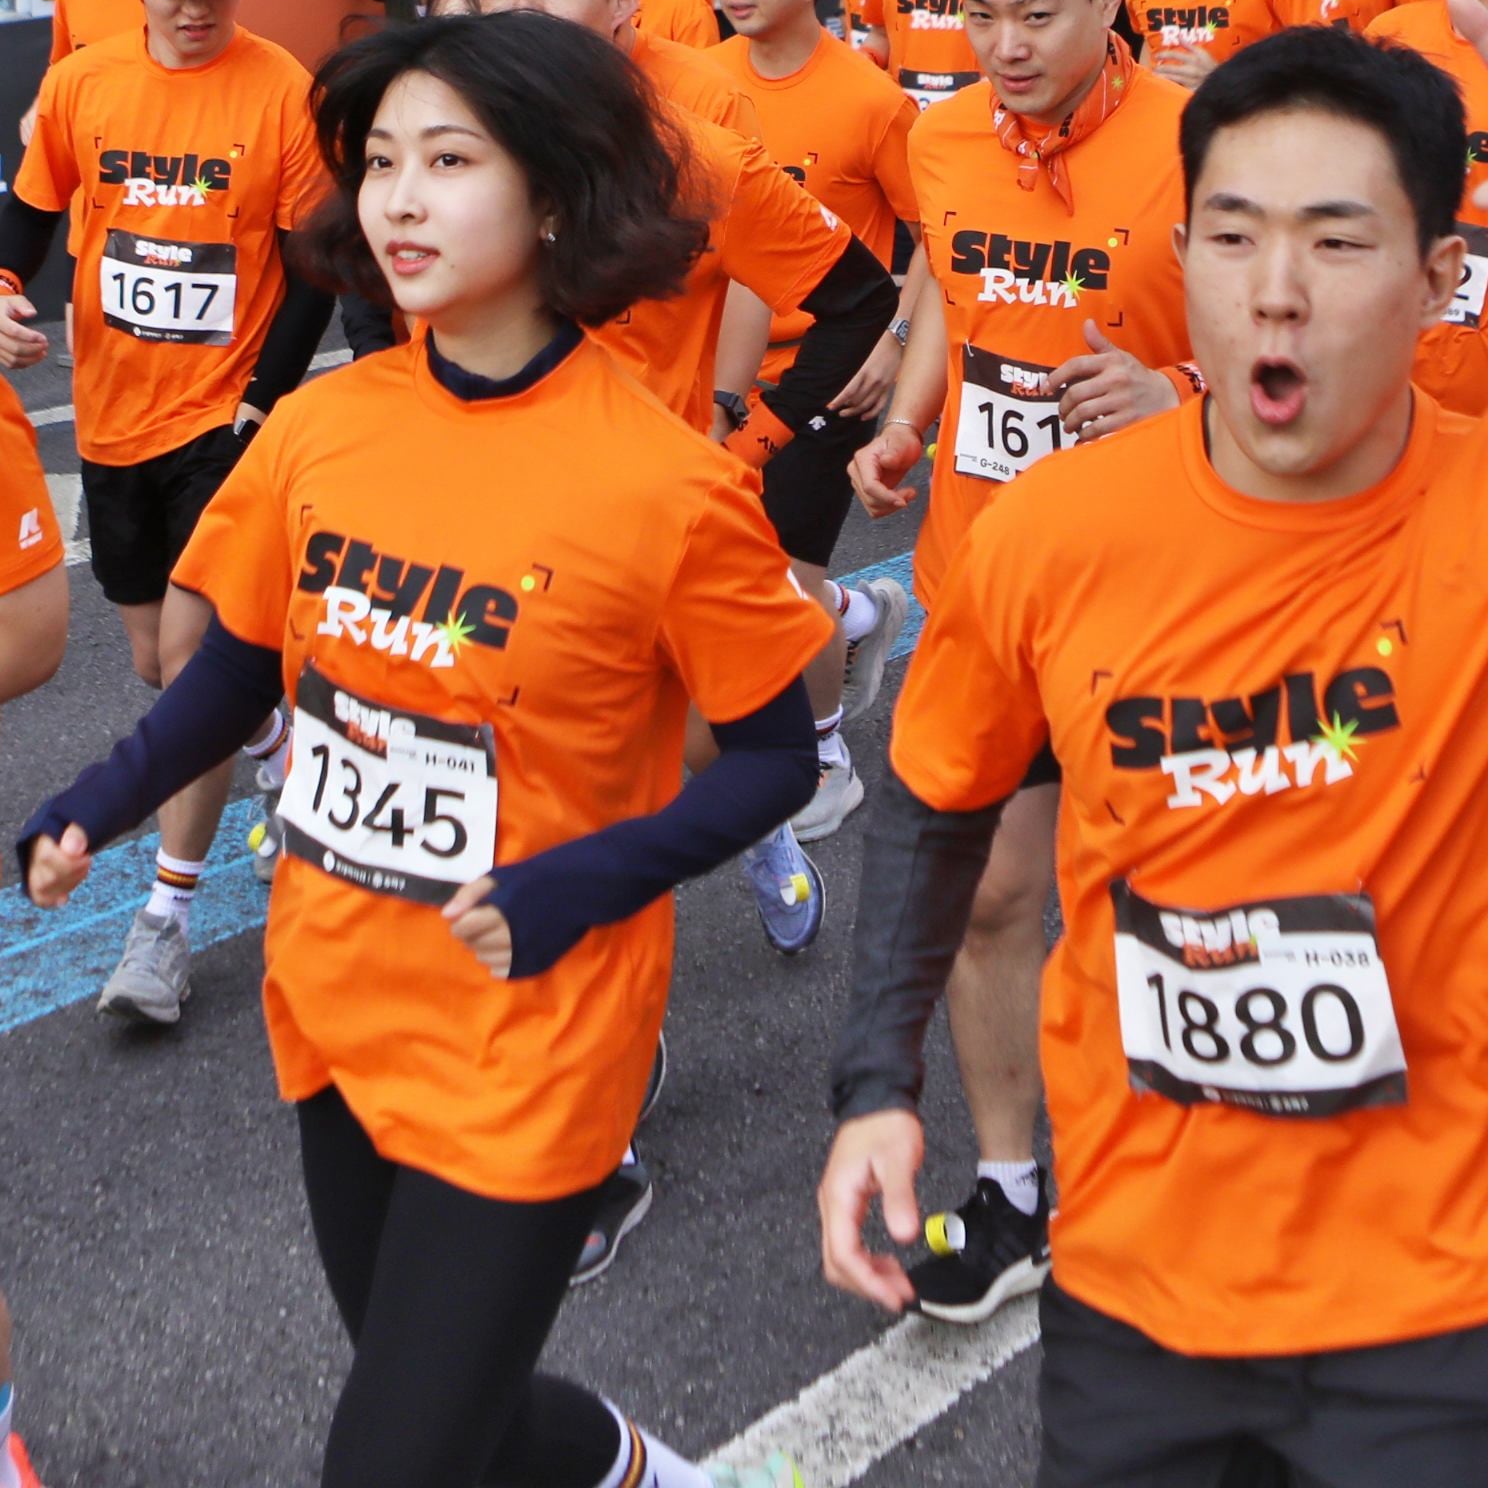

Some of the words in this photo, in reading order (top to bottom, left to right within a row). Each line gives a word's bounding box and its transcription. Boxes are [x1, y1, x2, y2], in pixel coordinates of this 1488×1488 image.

[1145, 6, 1230, 32] Style
[1160, 24, 1216, 47] Run
[98, 149, 232, 191] Style
[122, 176, 206, 208] Run
[134, 239, 193, 264] Style
[950, 229, 1111, 291] Style
[111, 272, 220, 322] 1617
[976, 267, 1078, 309] Run
[979, 457, 1011, 477] G-248
[296, 530, 519, 651] Style
[316, 585, 455, 669] Run
[333, 689, 417, 739] Style
[1105, 666, 1403, 770] Style
[424, 750, 476, 774] H-041
[1160, 738, 1355, 809] Run
[311, 742, 469, 859] 1345
[1304, 951, 1371, 969] H-038
[1146, 972, 1366, 1068] 1880
